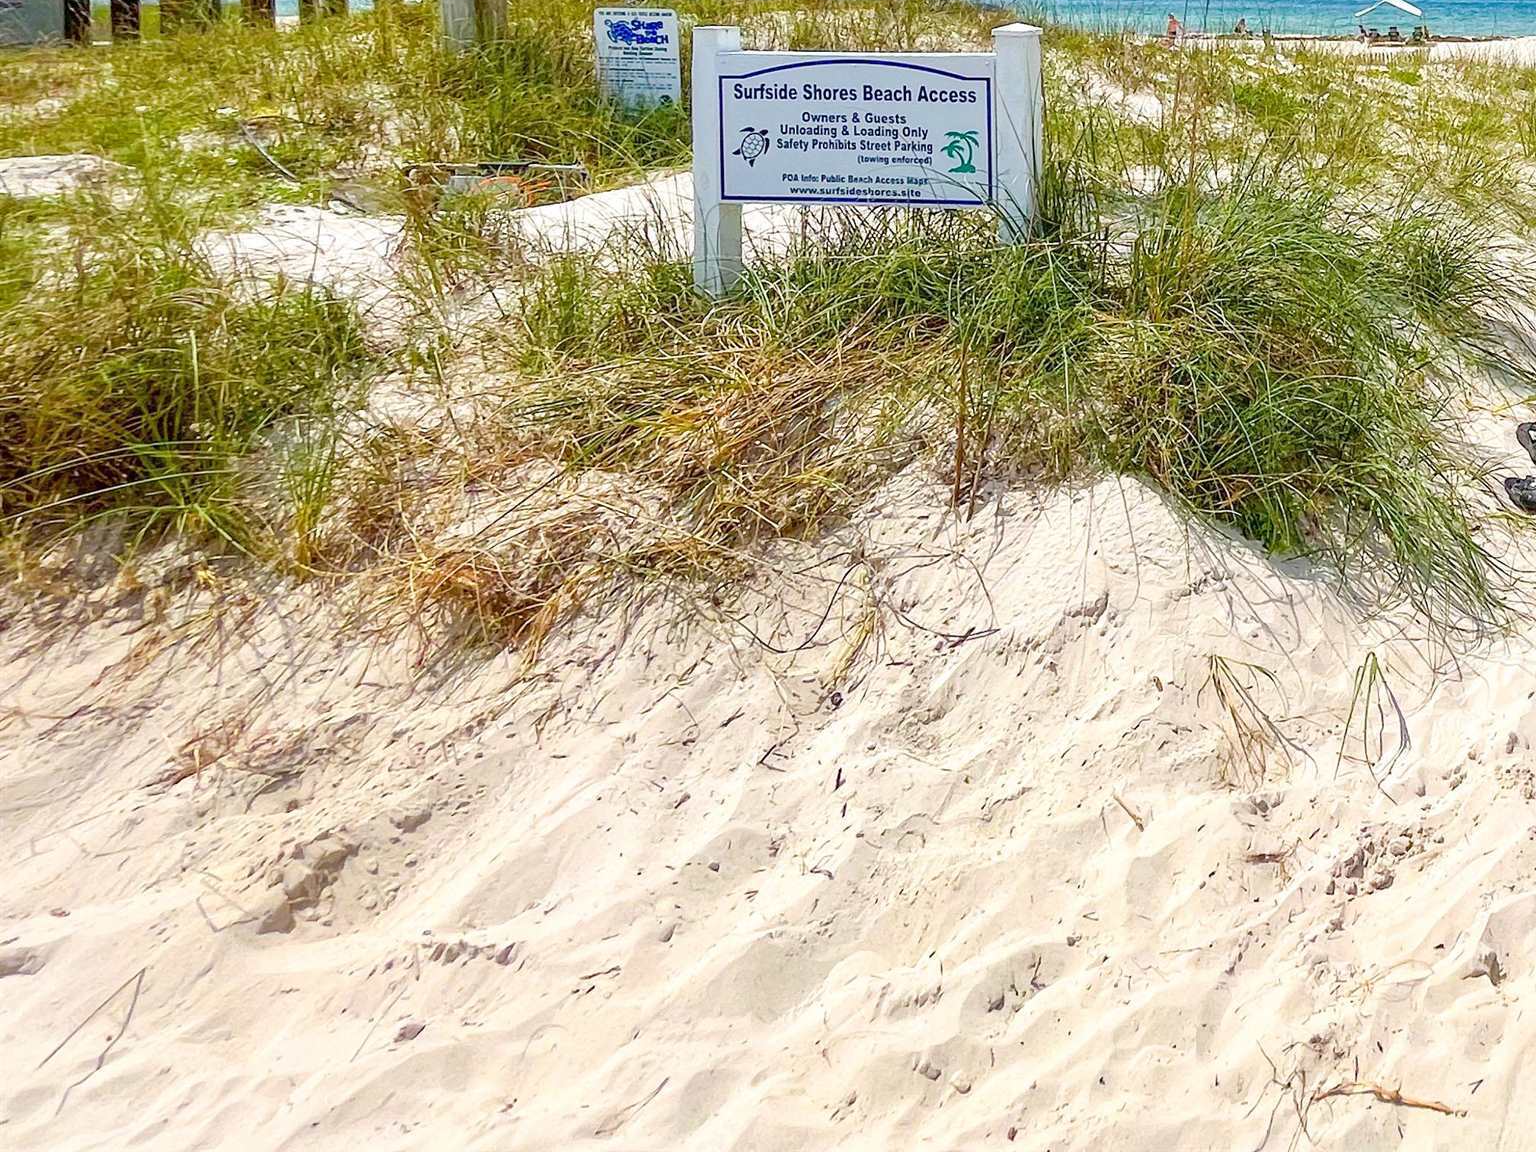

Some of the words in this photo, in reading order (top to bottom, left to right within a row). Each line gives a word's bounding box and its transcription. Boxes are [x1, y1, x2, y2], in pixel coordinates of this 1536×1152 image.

[733, 83, 798, 100] Surfside
[802, 83, 857, 101] Shores
[863, 84, 912, 102] Beach
[917, 85, 977, 103] Access
[801, 111, 847, 123] Owners
[851, 112, 860, 123] &
[864, 112, 907, 124] Guests
[780, 124, 837, 137] Unloading
[841, 125, 850, 136] &
[853, 126, 898, 139] Loading
[902, 127, 929, 139] Only
[776, 138, 809, 152] Safety
[811, 139, 857, 150] Prohibits
[859, 140, 891, 151] Street
[894, 141, 933, 154] Parking
[857, 155, 889, 165] (towing
[891, 156, 933, 166] enforced)
[800, 174, 819, 182] Info:
[820, 174, 846, 183] Public
[847, 175, 873, 184] Beach
[875, 176, 904, 185] Access
[789, 186, 921, 198] www.surfsideshores.site
